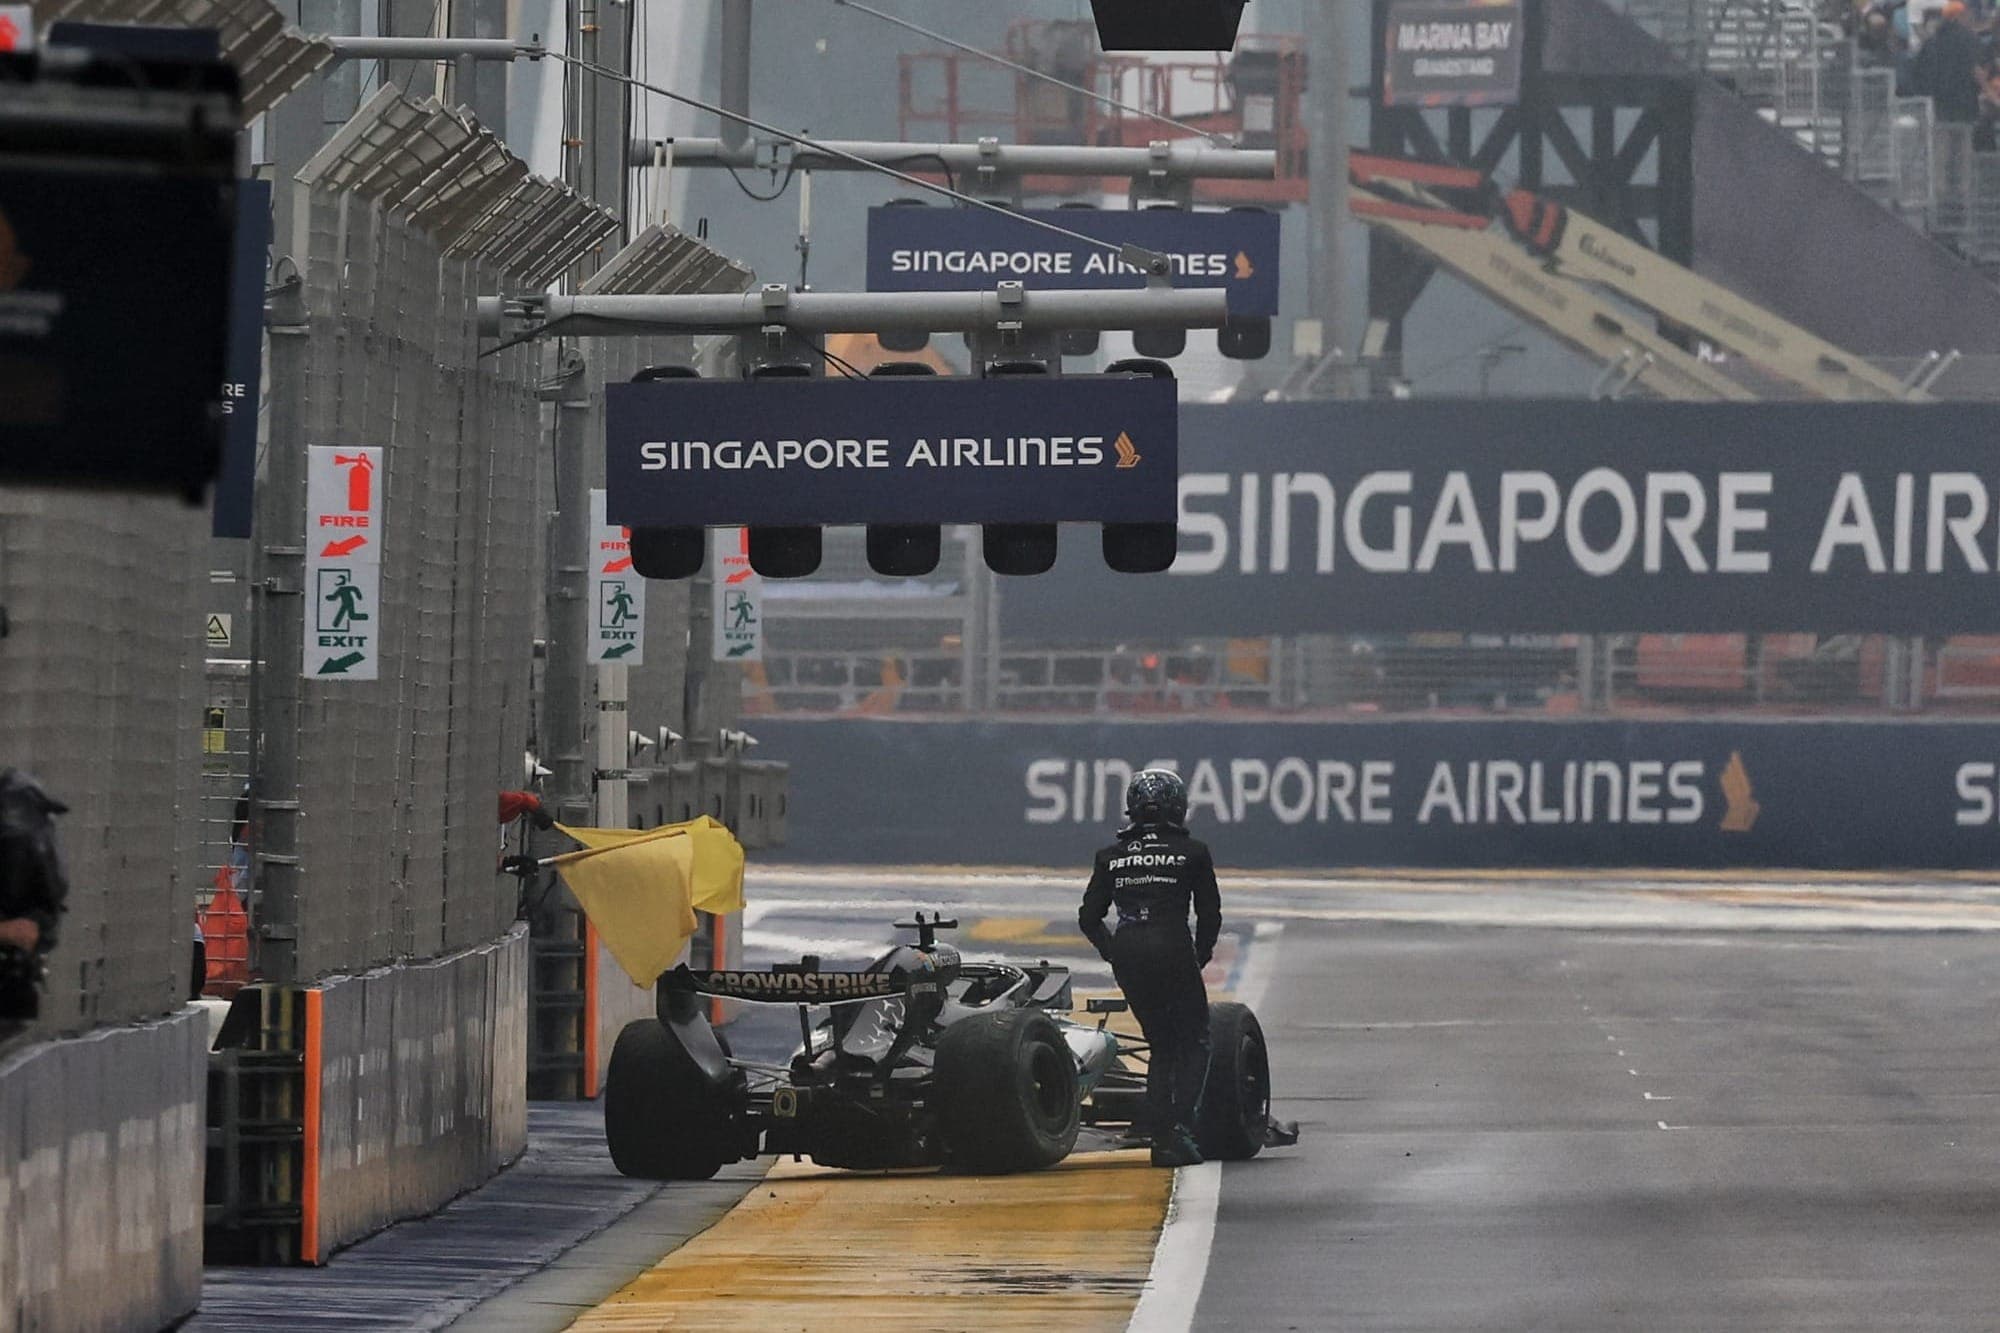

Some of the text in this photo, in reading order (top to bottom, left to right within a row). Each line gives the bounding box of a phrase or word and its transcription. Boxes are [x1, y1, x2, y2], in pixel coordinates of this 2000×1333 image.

[1398, 21, 1511, 49] MARINA BAY
[892, 250, 1227, 275] SINGAPORE AIRNES
[640, 437, 1104, 470] SINGAPORE AIRLINES
[319, 515, 369, 527] FIRE
[1168, 468, 2000, 576] SINGAPORE AIR
[600, 542, 631, 551] FIR
[318, 636, 367, 647] EXIT
[600, 631, 637, 640] EXIT
[1025, 757, 1704, 824] SINAPORE AIRLINES
[1109, 854, 1187, 871] PETRONAS
[708, 973, 891, 995] CROWDSTRIKE
